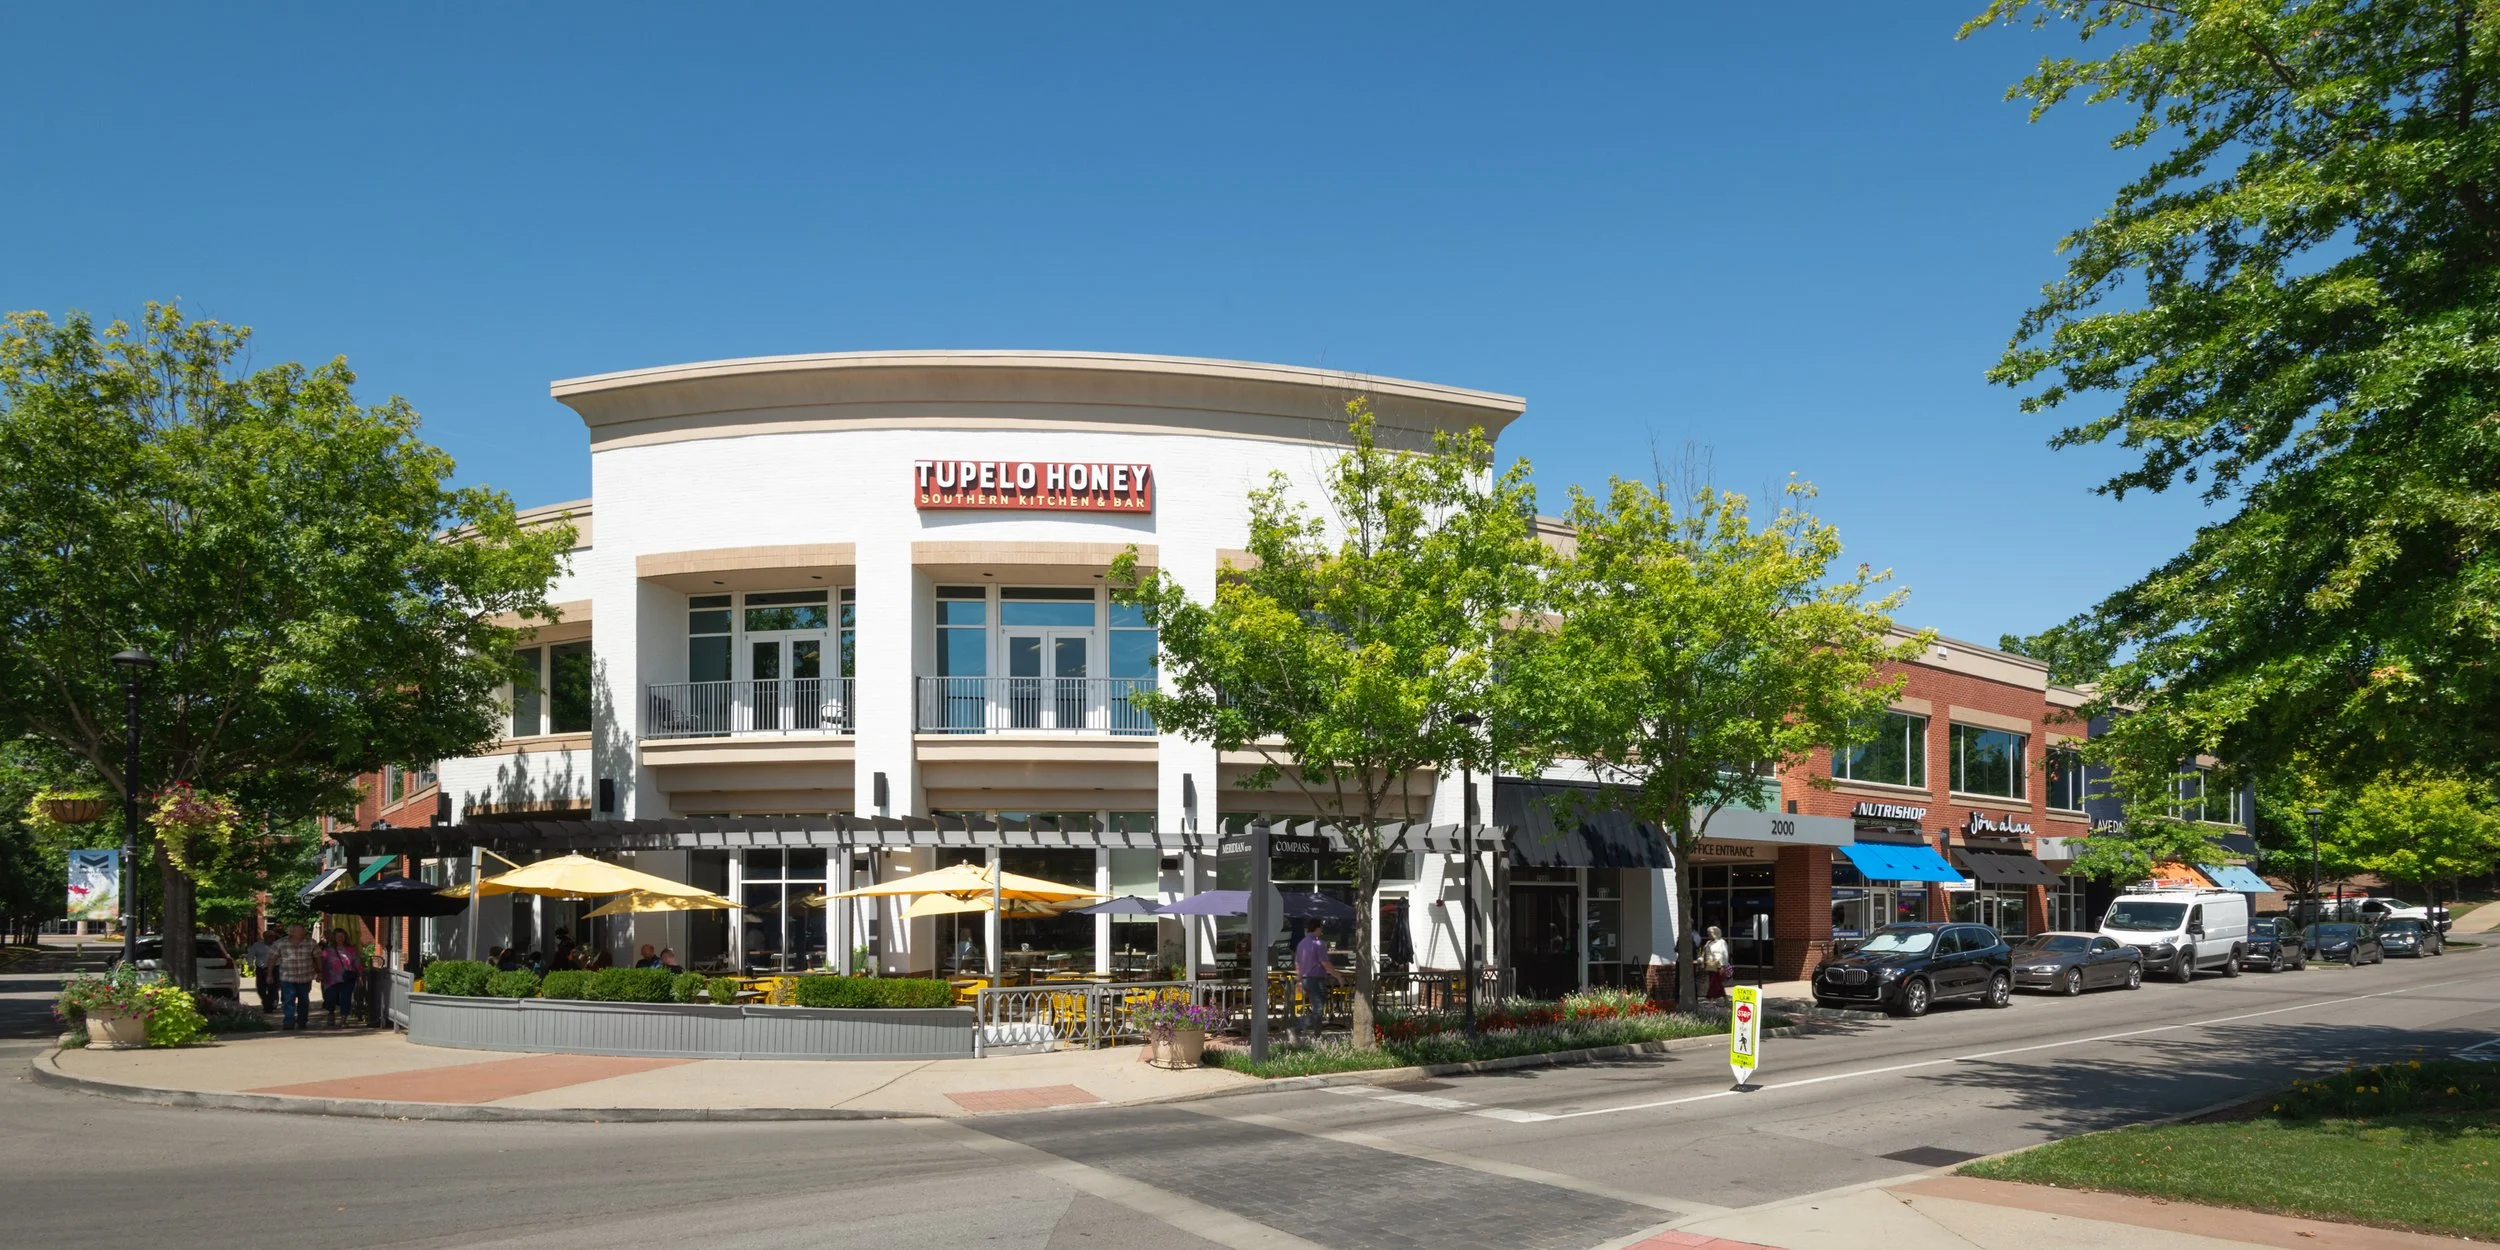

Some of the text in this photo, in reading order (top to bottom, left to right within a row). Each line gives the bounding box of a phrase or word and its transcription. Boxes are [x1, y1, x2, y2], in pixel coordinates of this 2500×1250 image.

[915, 461, 1148, 491] TUPELO HONEY
[921, 494, 1145, 508] SOUTHERN KITCHEN & BAR
[1858, 802, 1927, 820] NUTRISHOP
[1771, 820, 1795, 836] 2000
[1971, 811, 2036, 835] jón alan
[2097, 818, 2125, 834] AVEDA
[1222, 842, 1245, 854] MERIDIAN
[1275, 840, 1310, 852] COMPASS
[1716, 845, 1755, 857] ENTRANCE
[1737, 988, 1753, 996] STATE
[1738, 1010, 1751, 1018] STOP
